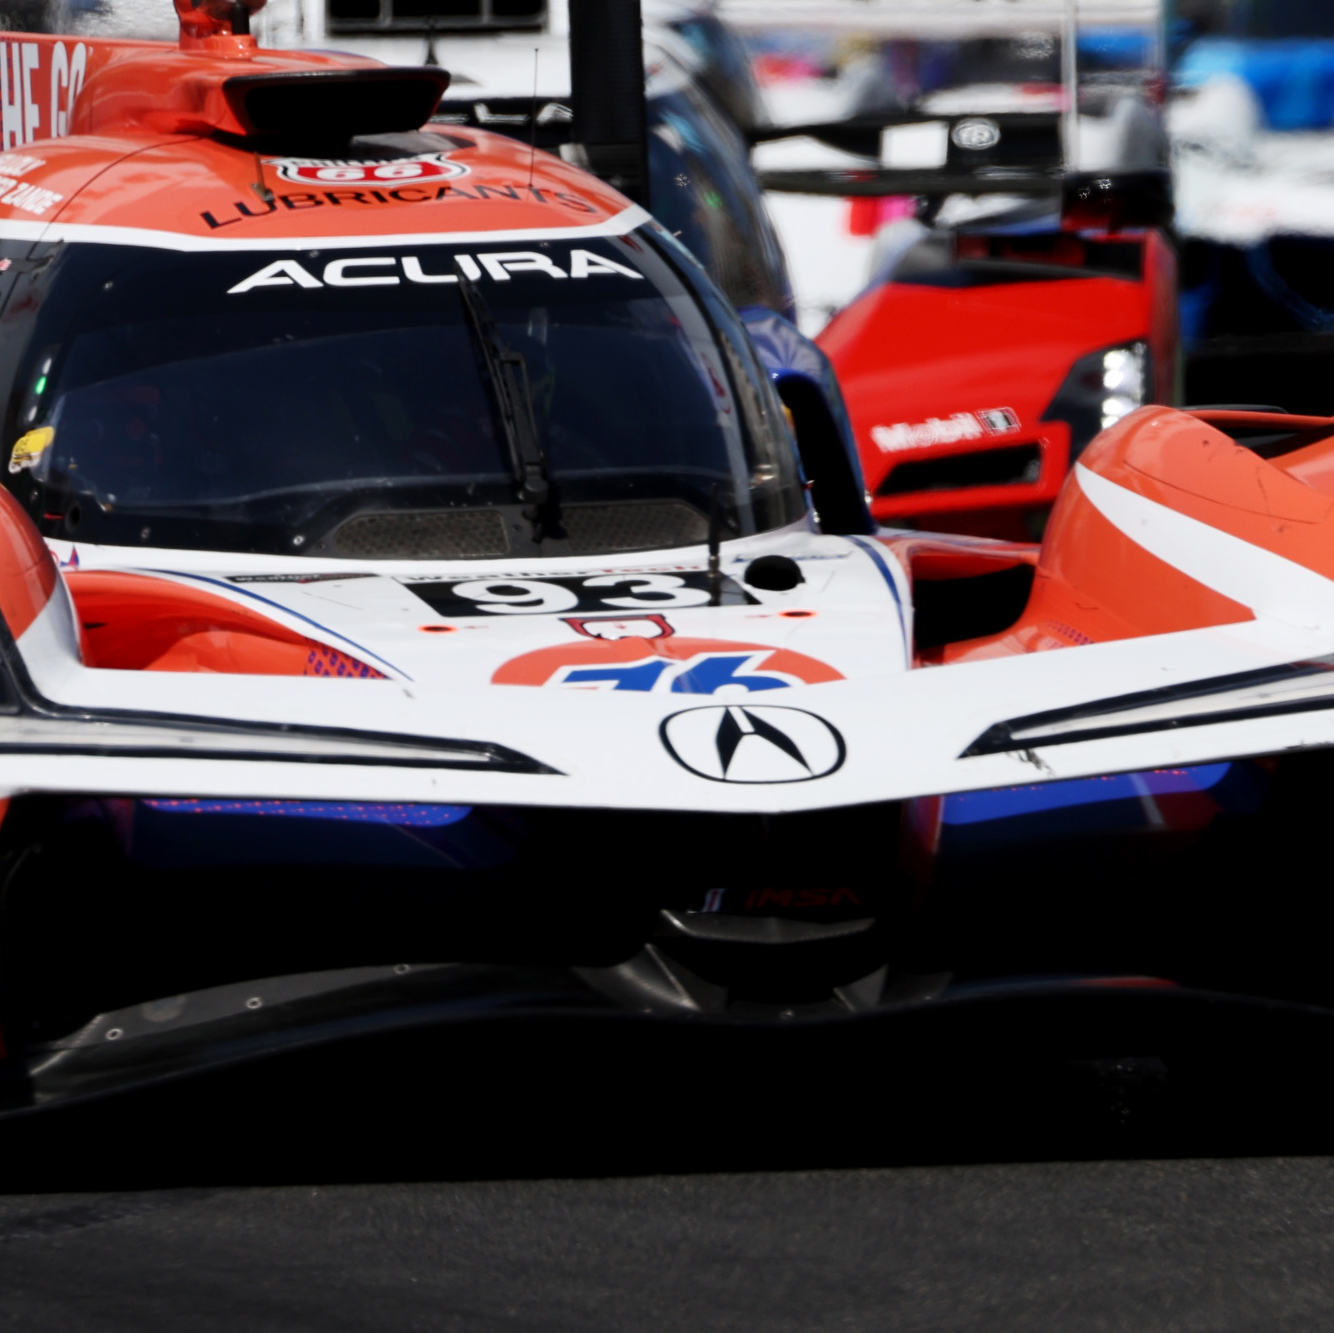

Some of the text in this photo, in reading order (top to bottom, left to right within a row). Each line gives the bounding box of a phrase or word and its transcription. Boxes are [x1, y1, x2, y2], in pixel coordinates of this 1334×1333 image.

[316, 163, 423, 181] 66
[199, 183, 599, 229] LUBRICANTS
[227, 249, 644, 294] ACURA
[870, 412, 984, 454] Mobil
[452, 573, 712, 615] 93
